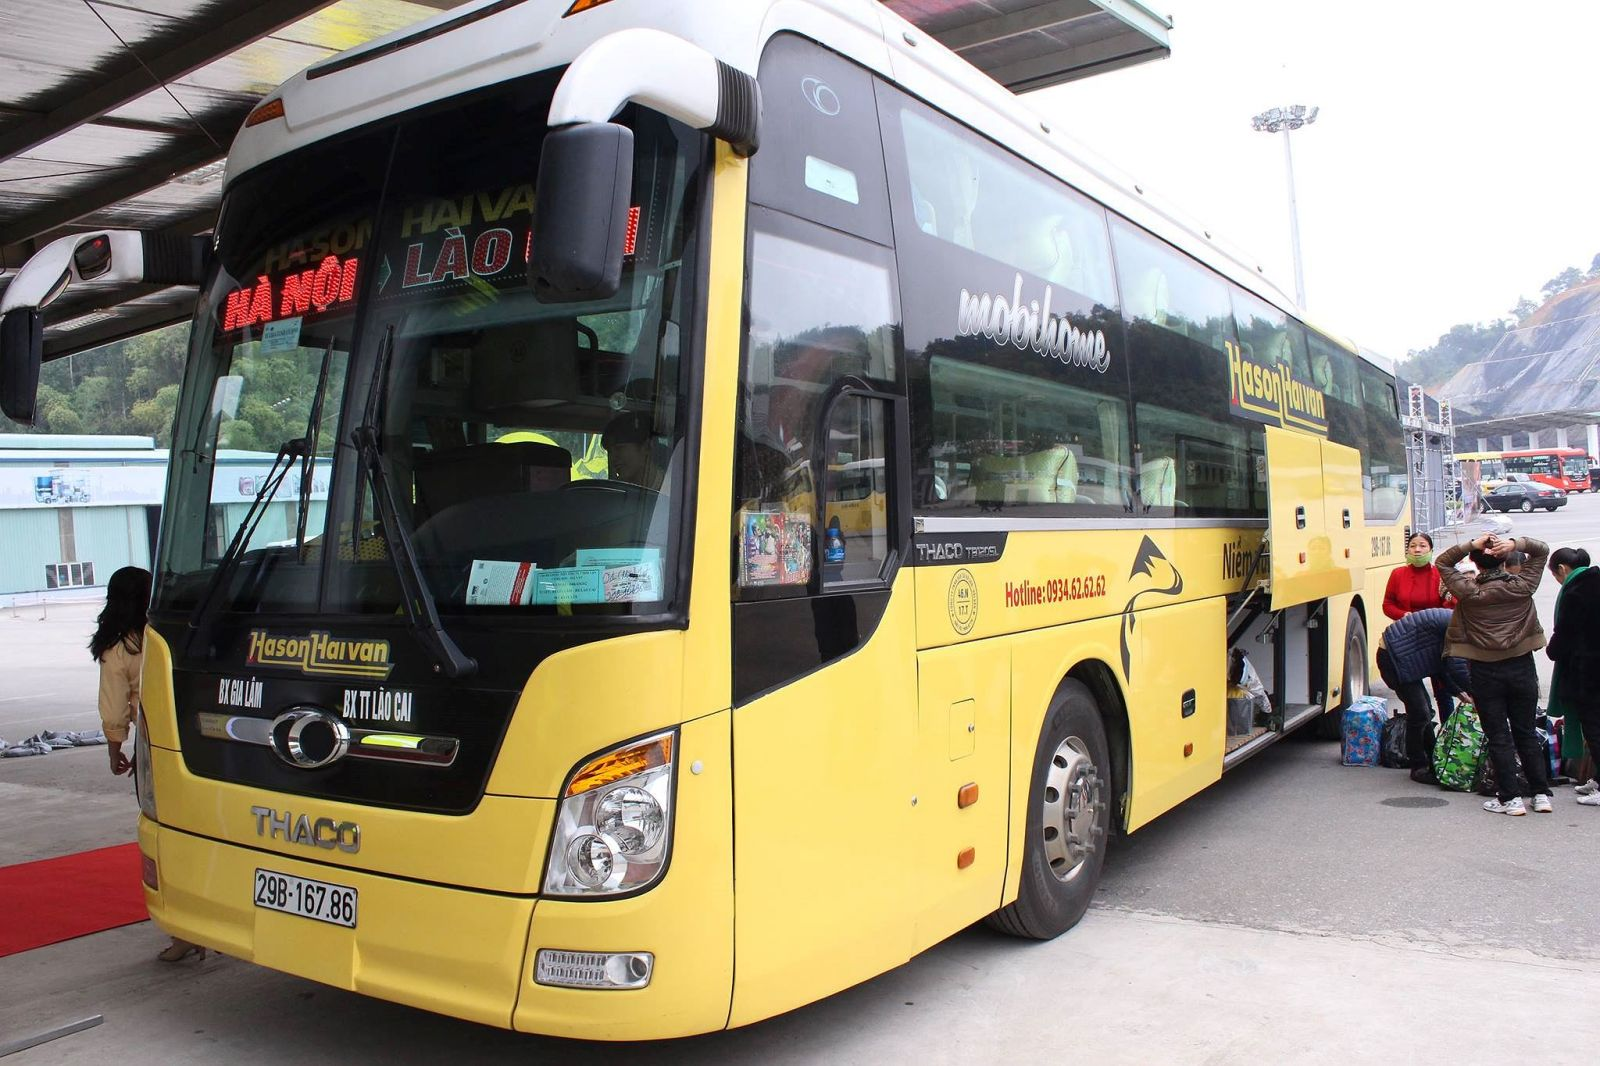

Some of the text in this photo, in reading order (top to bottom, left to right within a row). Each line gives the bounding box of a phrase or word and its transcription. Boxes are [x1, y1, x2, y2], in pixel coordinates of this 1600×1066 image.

[402, 227, 513, 288] LÀO
[224, 274, 272, 332] HÀ
[280, 255, 358, 316] NỘI
[958, 272, 1111, 374] mobihome
[916, 542, 963, 561] THACO
[218, 676, 263, 709] BX GIA LÂM
[343, 689, 357, 719] BX
[359, 690, 371, 719] TT
[393, 692, 413, 722] CAI
[251, 805, 361, 855] THACO
[256, 873, 353, 922] 29B-167.86
